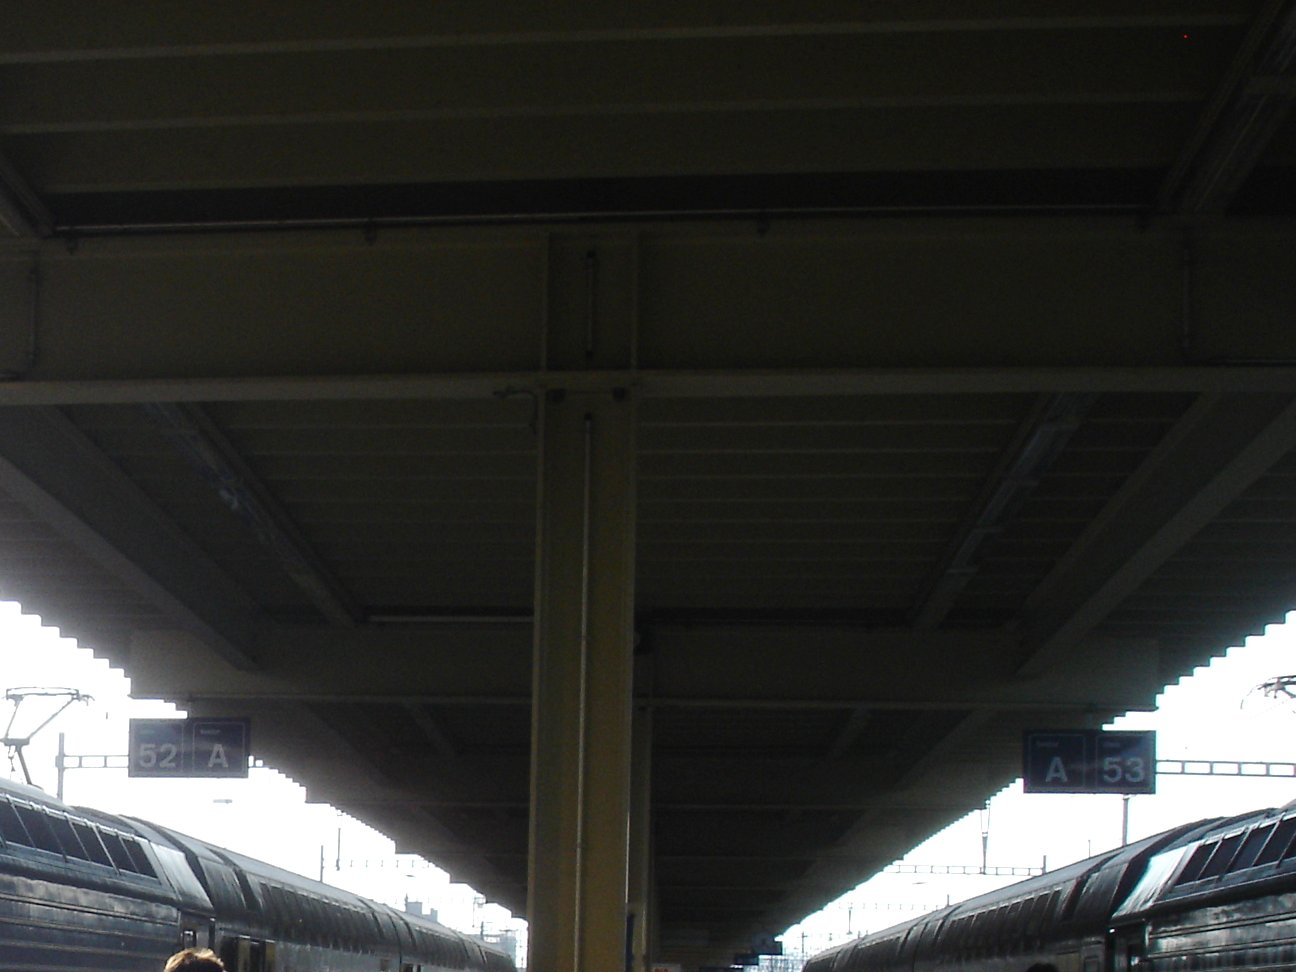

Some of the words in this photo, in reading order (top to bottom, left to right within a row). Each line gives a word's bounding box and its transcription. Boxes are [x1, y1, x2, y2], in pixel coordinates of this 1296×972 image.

[139, 743, 178, 768] 52
[207, 743, 229, 768] A
[1045, 756, 1068, 782] A
[1103, 756, 1146, 783] 53
